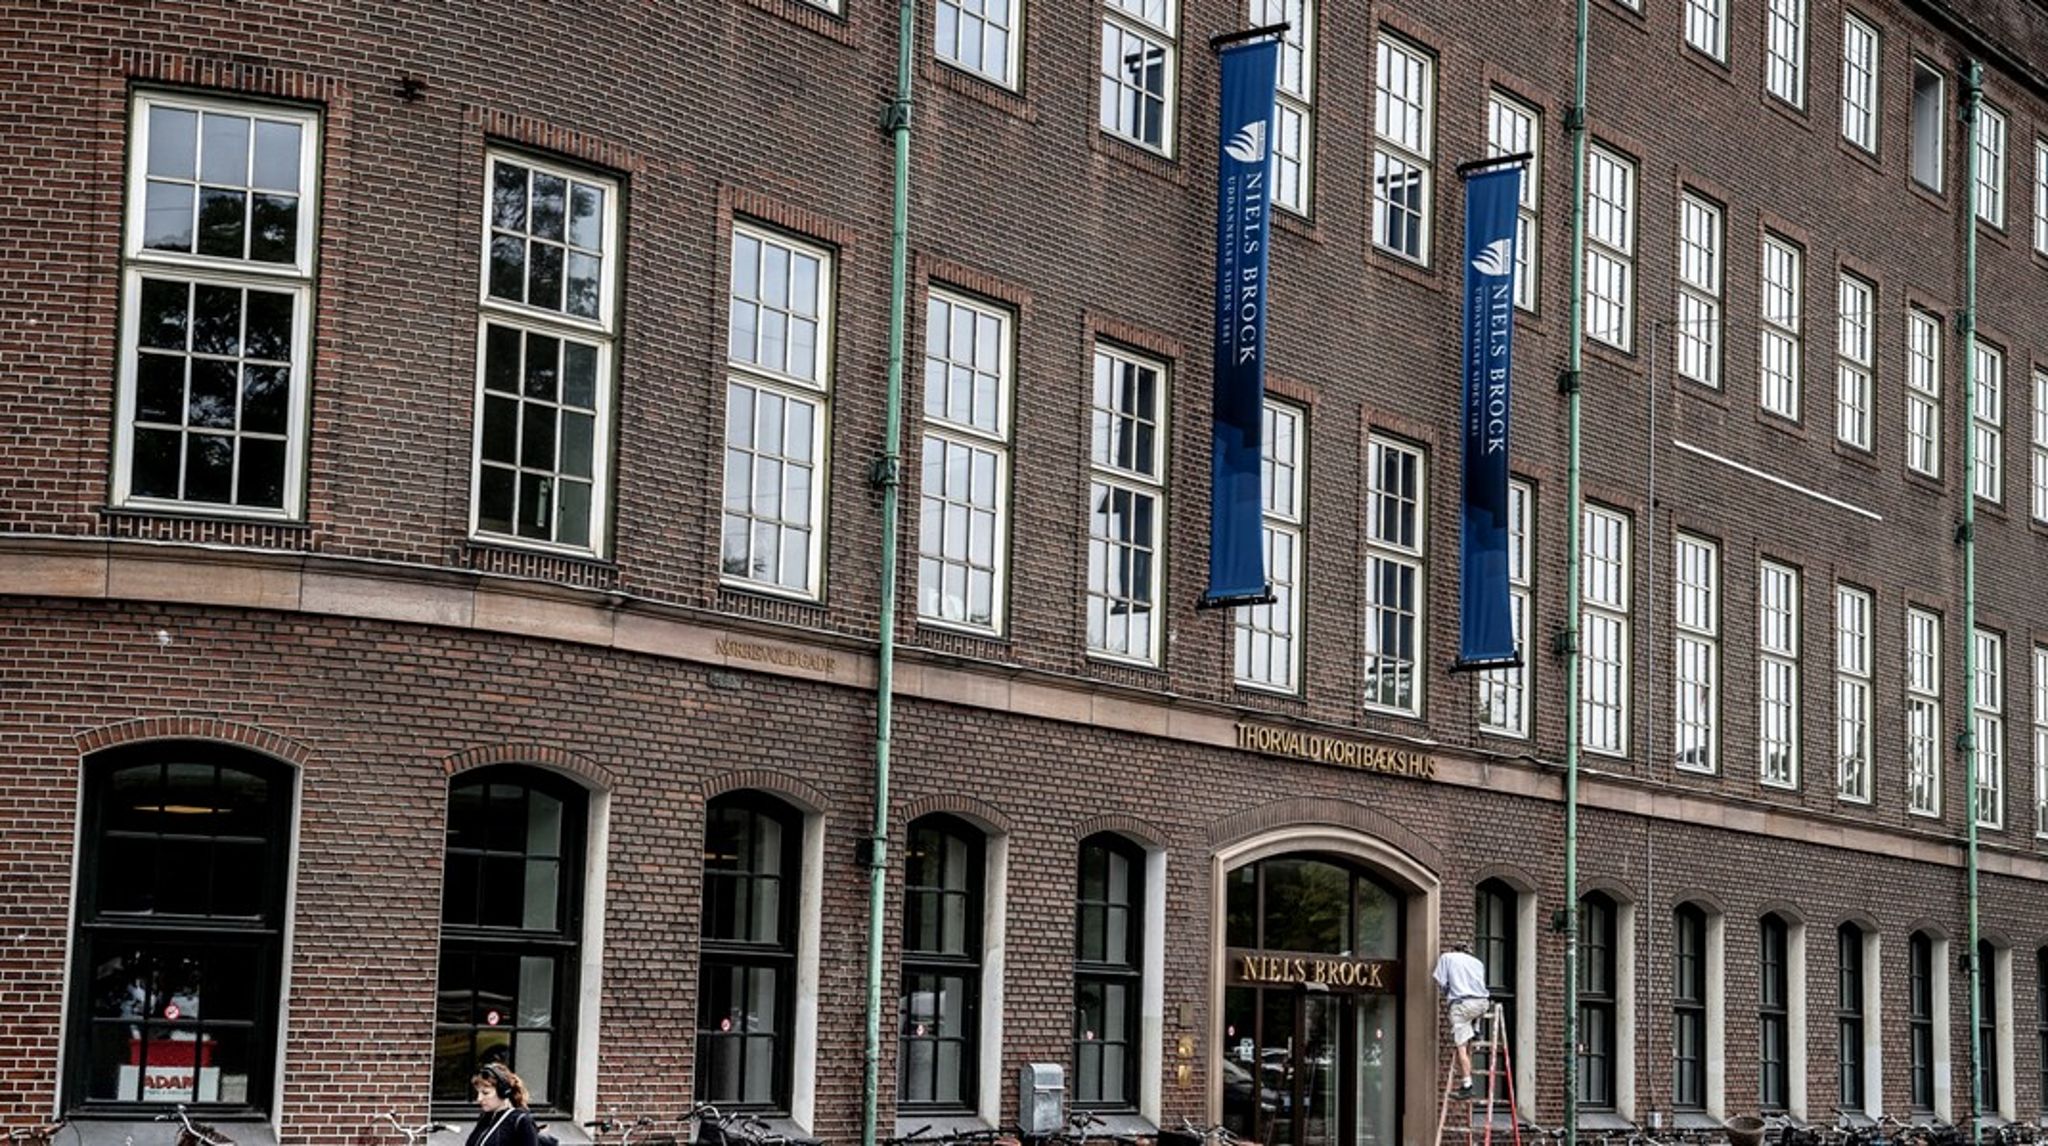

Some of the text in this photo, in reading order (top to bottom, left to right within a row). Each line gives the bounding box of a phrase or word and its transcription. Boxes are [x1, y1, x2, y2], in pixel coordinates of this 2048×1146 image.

[1224, 176, 1236, 266] UDDANNELSE
[1223, 270, 1233, 311] SIDEN
[1239, 171, 1262, 366] NIELS BROCK
[1471, 370, 1480, 406] SIDEN
[1488, 284, 1509, 454] NIELS BROCK
[1235, 722, 1436, 779] THORVALD KORTBÆKS HUS
[1242, 954, 1384, 988] NIELS BROCK
